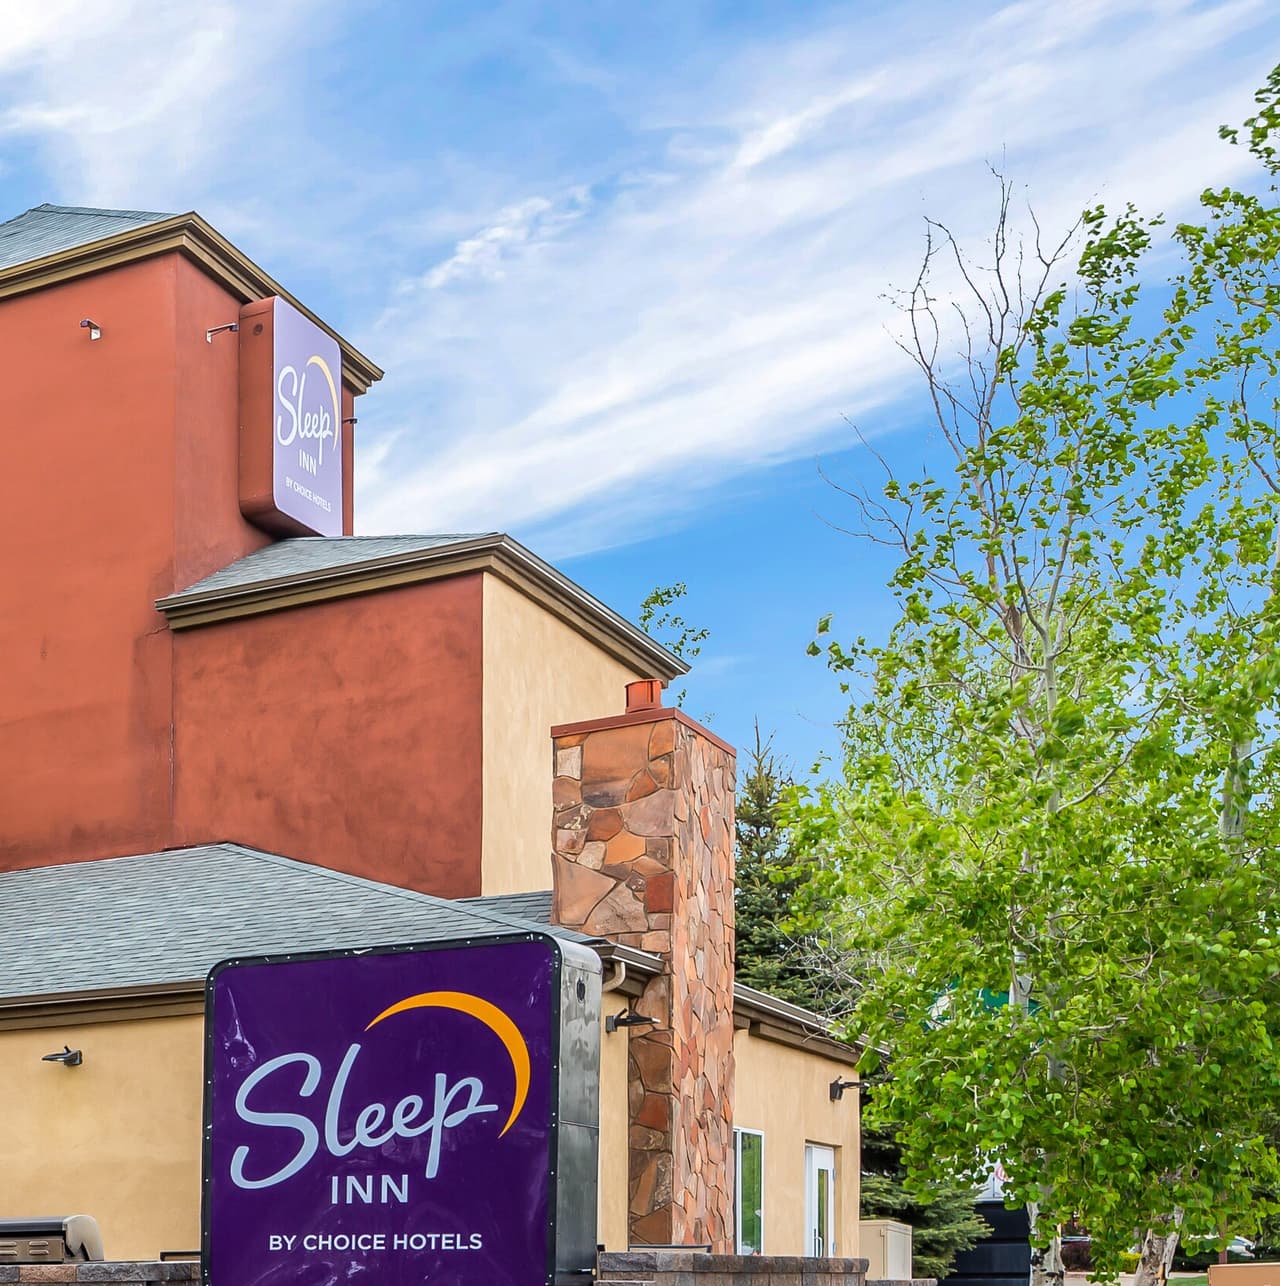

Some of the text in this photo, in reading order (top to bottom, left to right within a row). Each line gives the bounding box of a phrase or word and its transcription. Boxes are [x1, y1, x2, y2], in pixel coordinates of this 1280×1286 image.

[277, 365, 333, 466] Sleep
[299, 448, 317, 477] INN
[293, 481, 313, 501] CHOICE
[230, 1043, 499, 1190] Sleep
[331, 1174, 409, 1205] INN
[268, 1232, 483, 1252] BY CHOICE HOTELS
